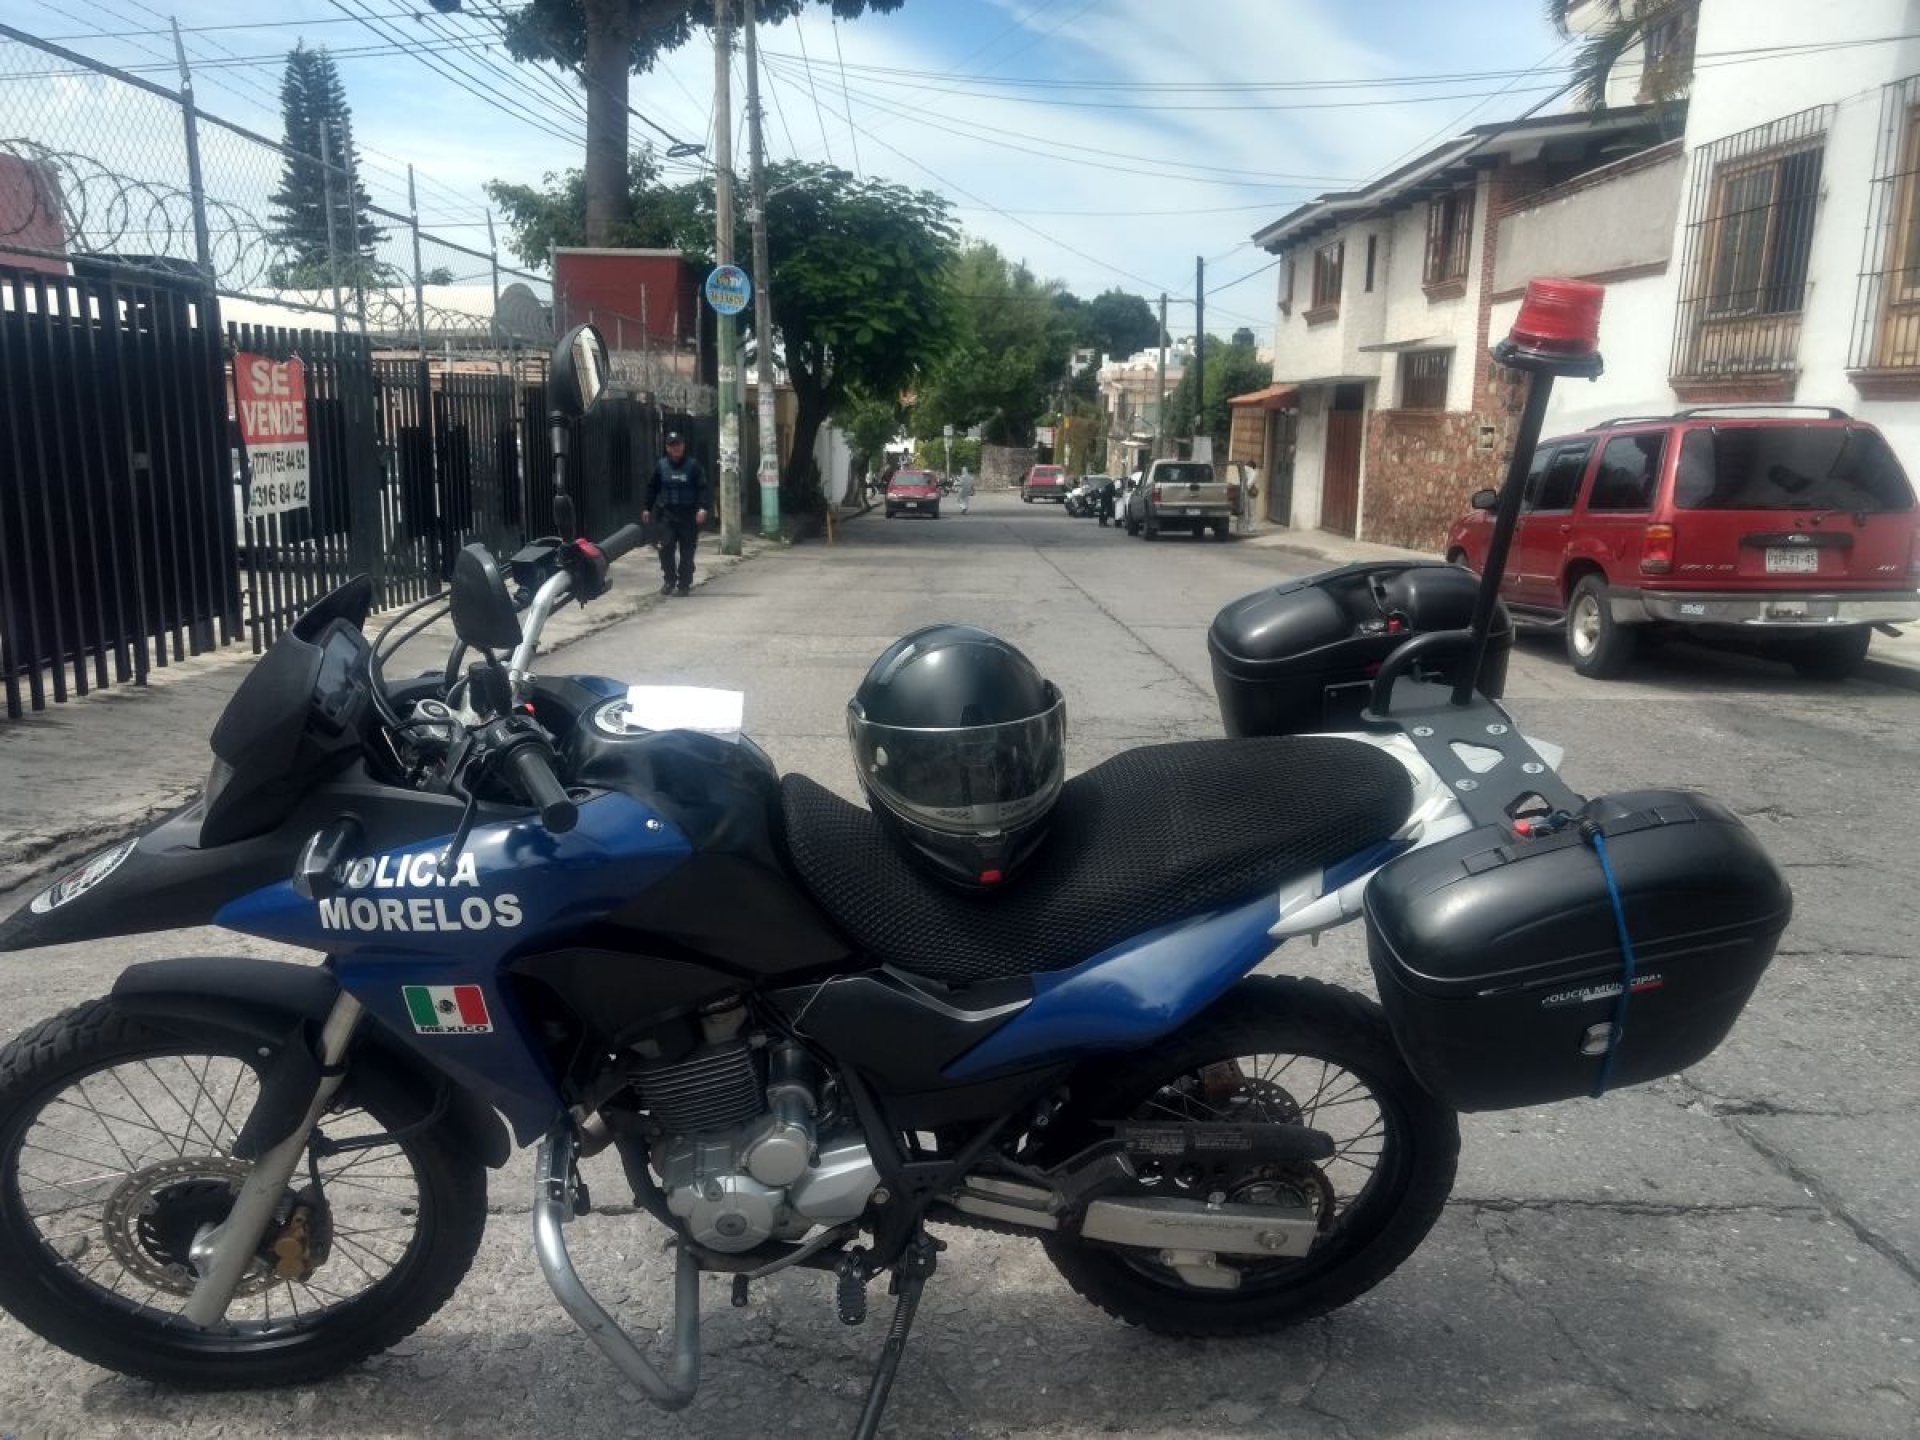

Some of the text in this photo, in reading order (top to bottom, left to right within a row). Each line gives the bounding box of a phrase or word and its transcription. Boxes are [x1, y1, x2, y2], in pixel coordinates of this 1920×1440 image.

[251, 360, 291, 395] SE
[242, 401, 305, 436] VENDE
[340, 852, 481, 889] OLICA
[319, 894, 523, 932] MORELOS
[420, 1025, 488, 1034] MEXICO
